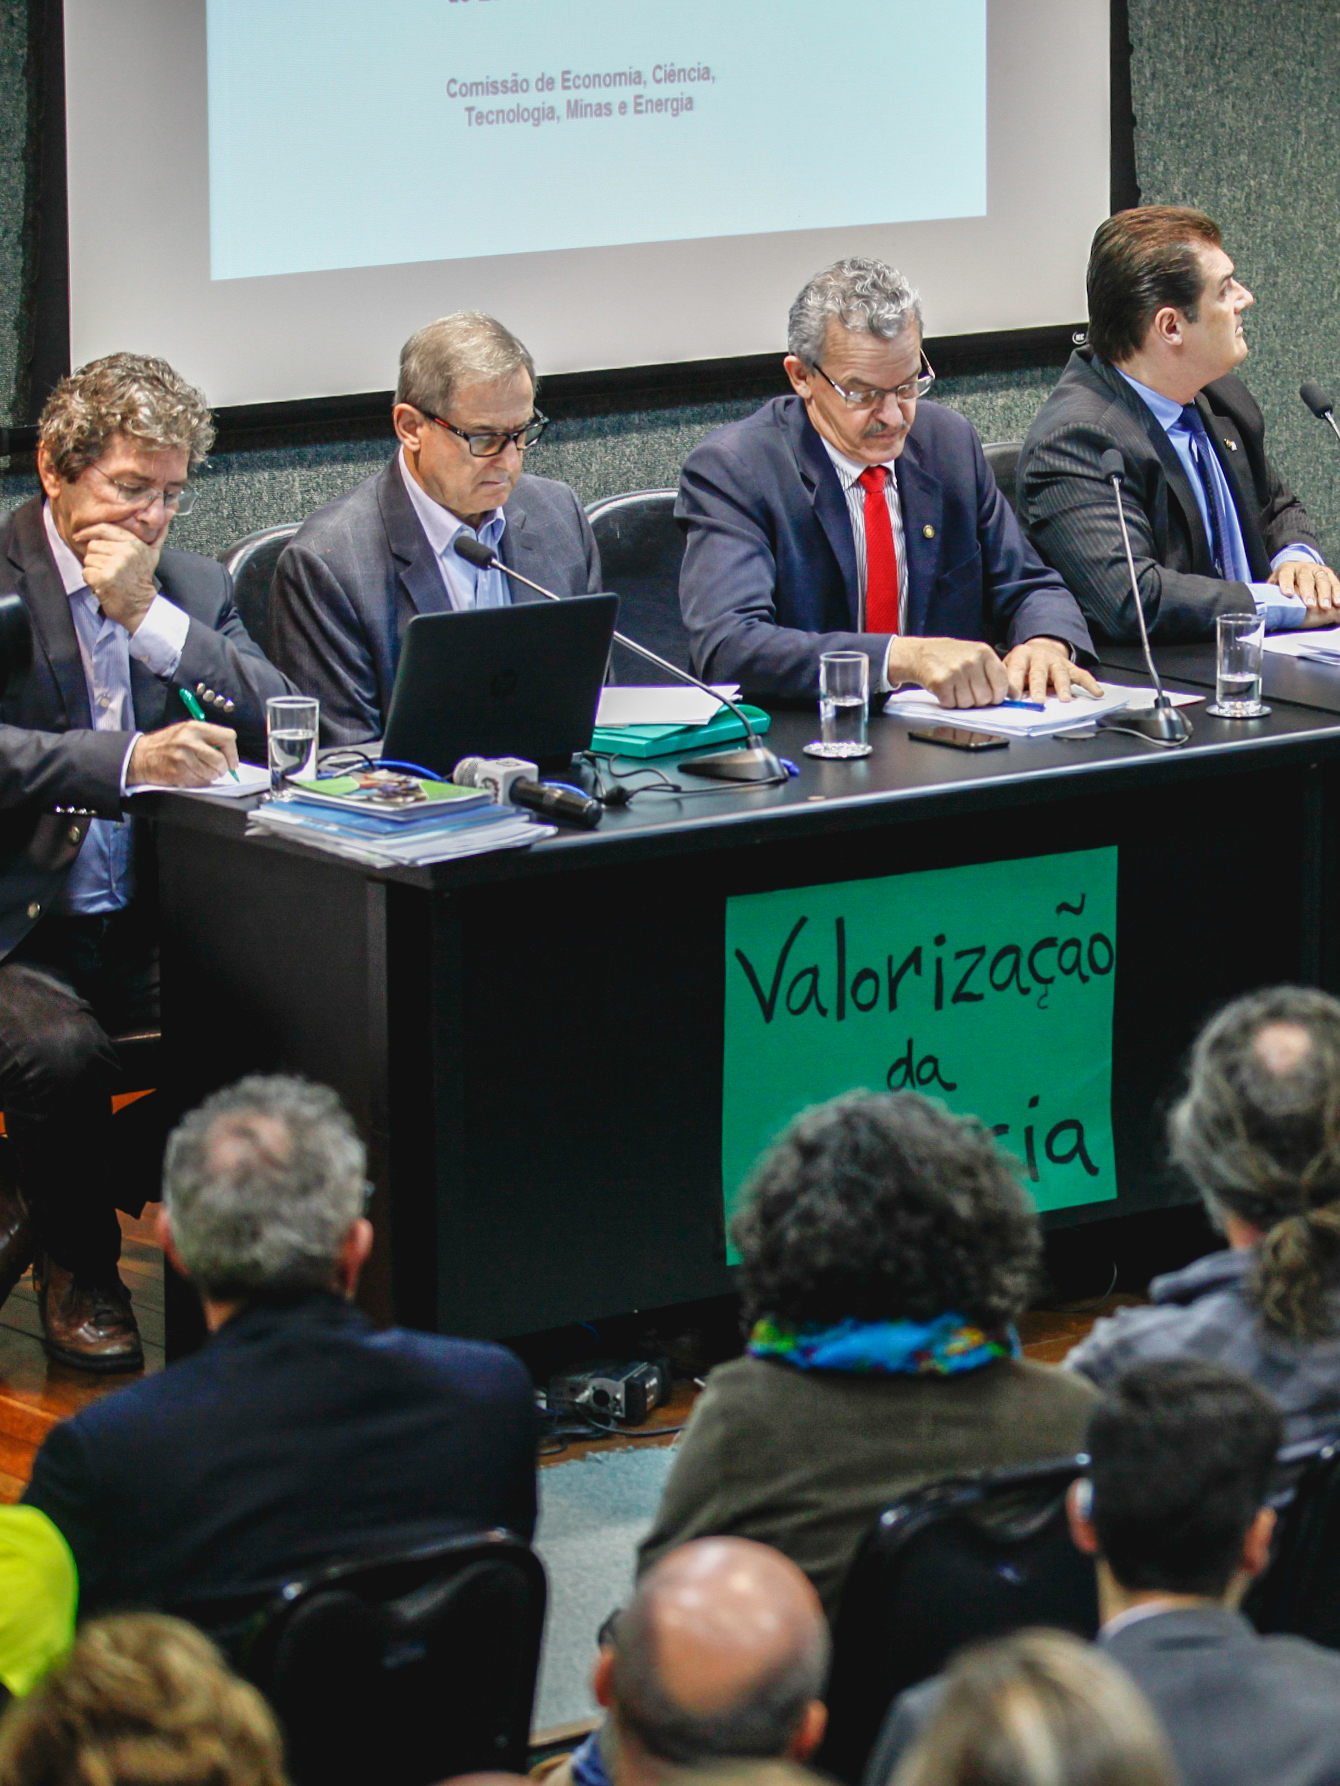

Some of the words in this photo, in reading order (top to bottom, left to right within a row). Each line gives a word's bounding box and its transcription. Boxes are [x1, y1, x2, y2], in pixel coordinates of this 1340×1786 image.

[446, 73, 530, 98] Comissão
[534, 72, 556, 93] de
[560, 66, 647, 91] Economia,
[652, 62, 716, 85] Ciência,
[464, 103, 560, 127] Tecnologia,
[566, 98, 613, 120] Minas
[617, 100, 628, 116] e
[633, 92, 694, 117] Energia
[734, 893, 1114, 1024] Valorização
[886, 1038, 957, 1092] da
